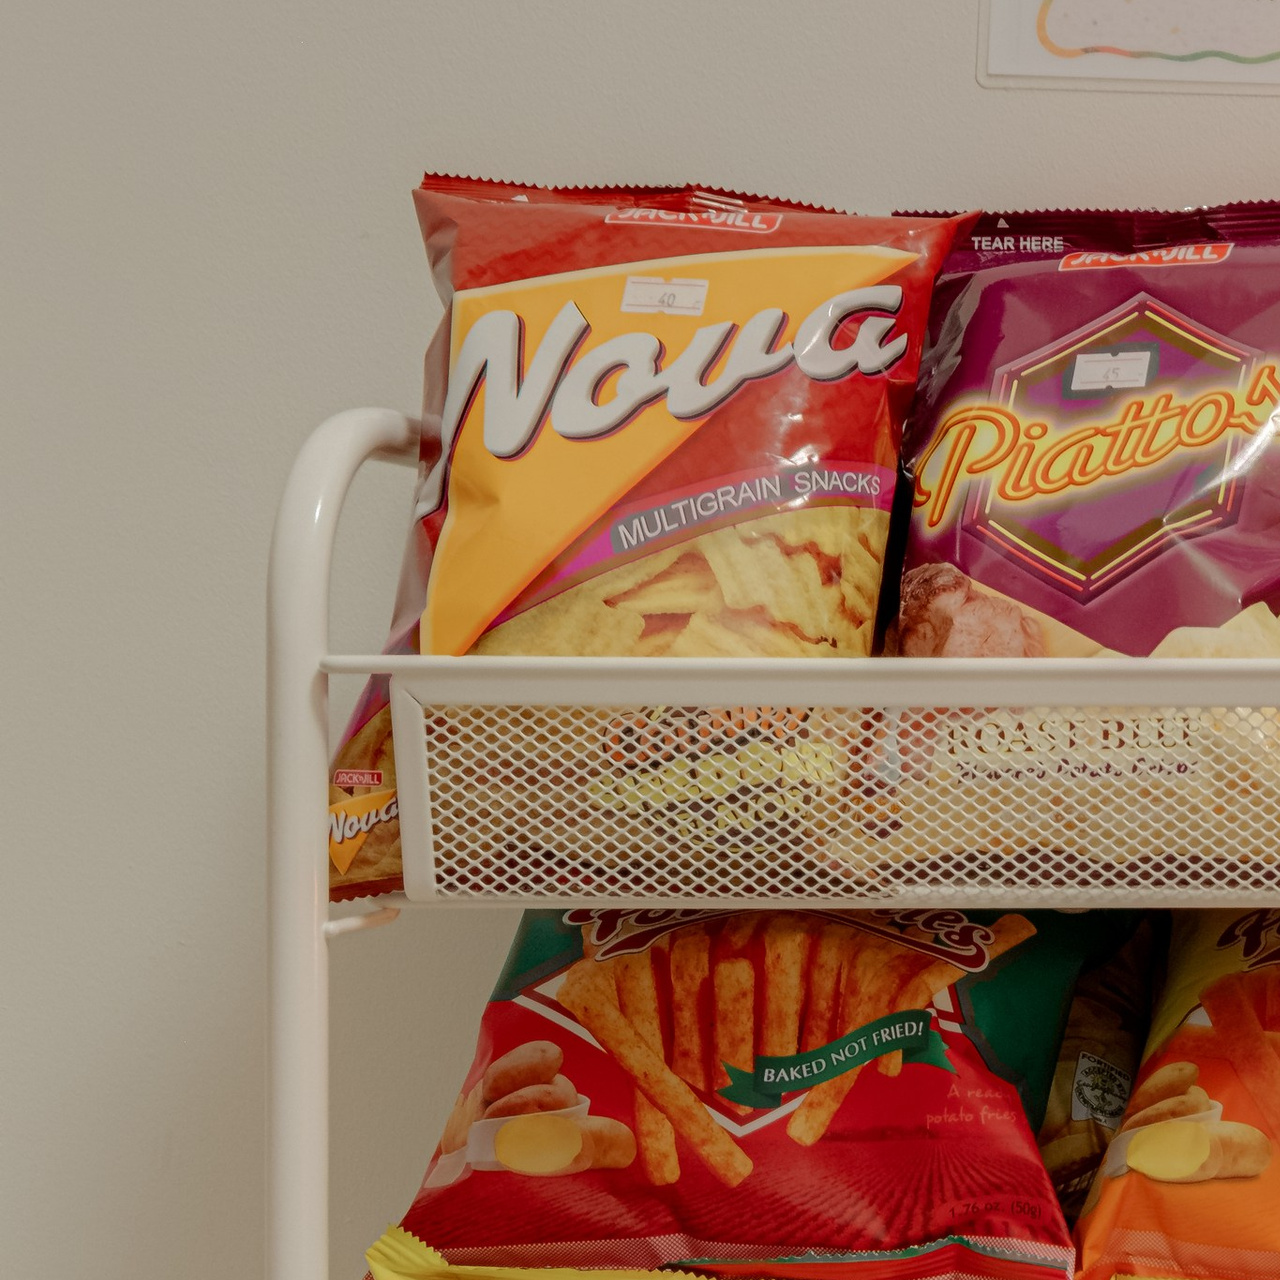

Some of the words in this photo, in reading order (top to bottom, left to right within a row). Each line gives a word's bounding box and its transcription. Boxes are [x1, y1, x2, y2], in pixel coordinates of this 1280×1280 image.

[972, 236, 1015, 250] TEAR
[1020, 236, 1064, 252] HERE
[658, 293, 675, 307] 40
[1102, 368, 1120, 381] 45
[417, 286, 907, 519] Nova
[618, 476, 782, 549] MULTIGRAIN
[793, 471, 881, 495] SNACKS
[763, 1058, 827, 1083] BAKED
[831, 1037, 868, 1065] NOT
[872, 1021, 924, 1044] FRIED!
[927, 1110, 973, 1129] potato
